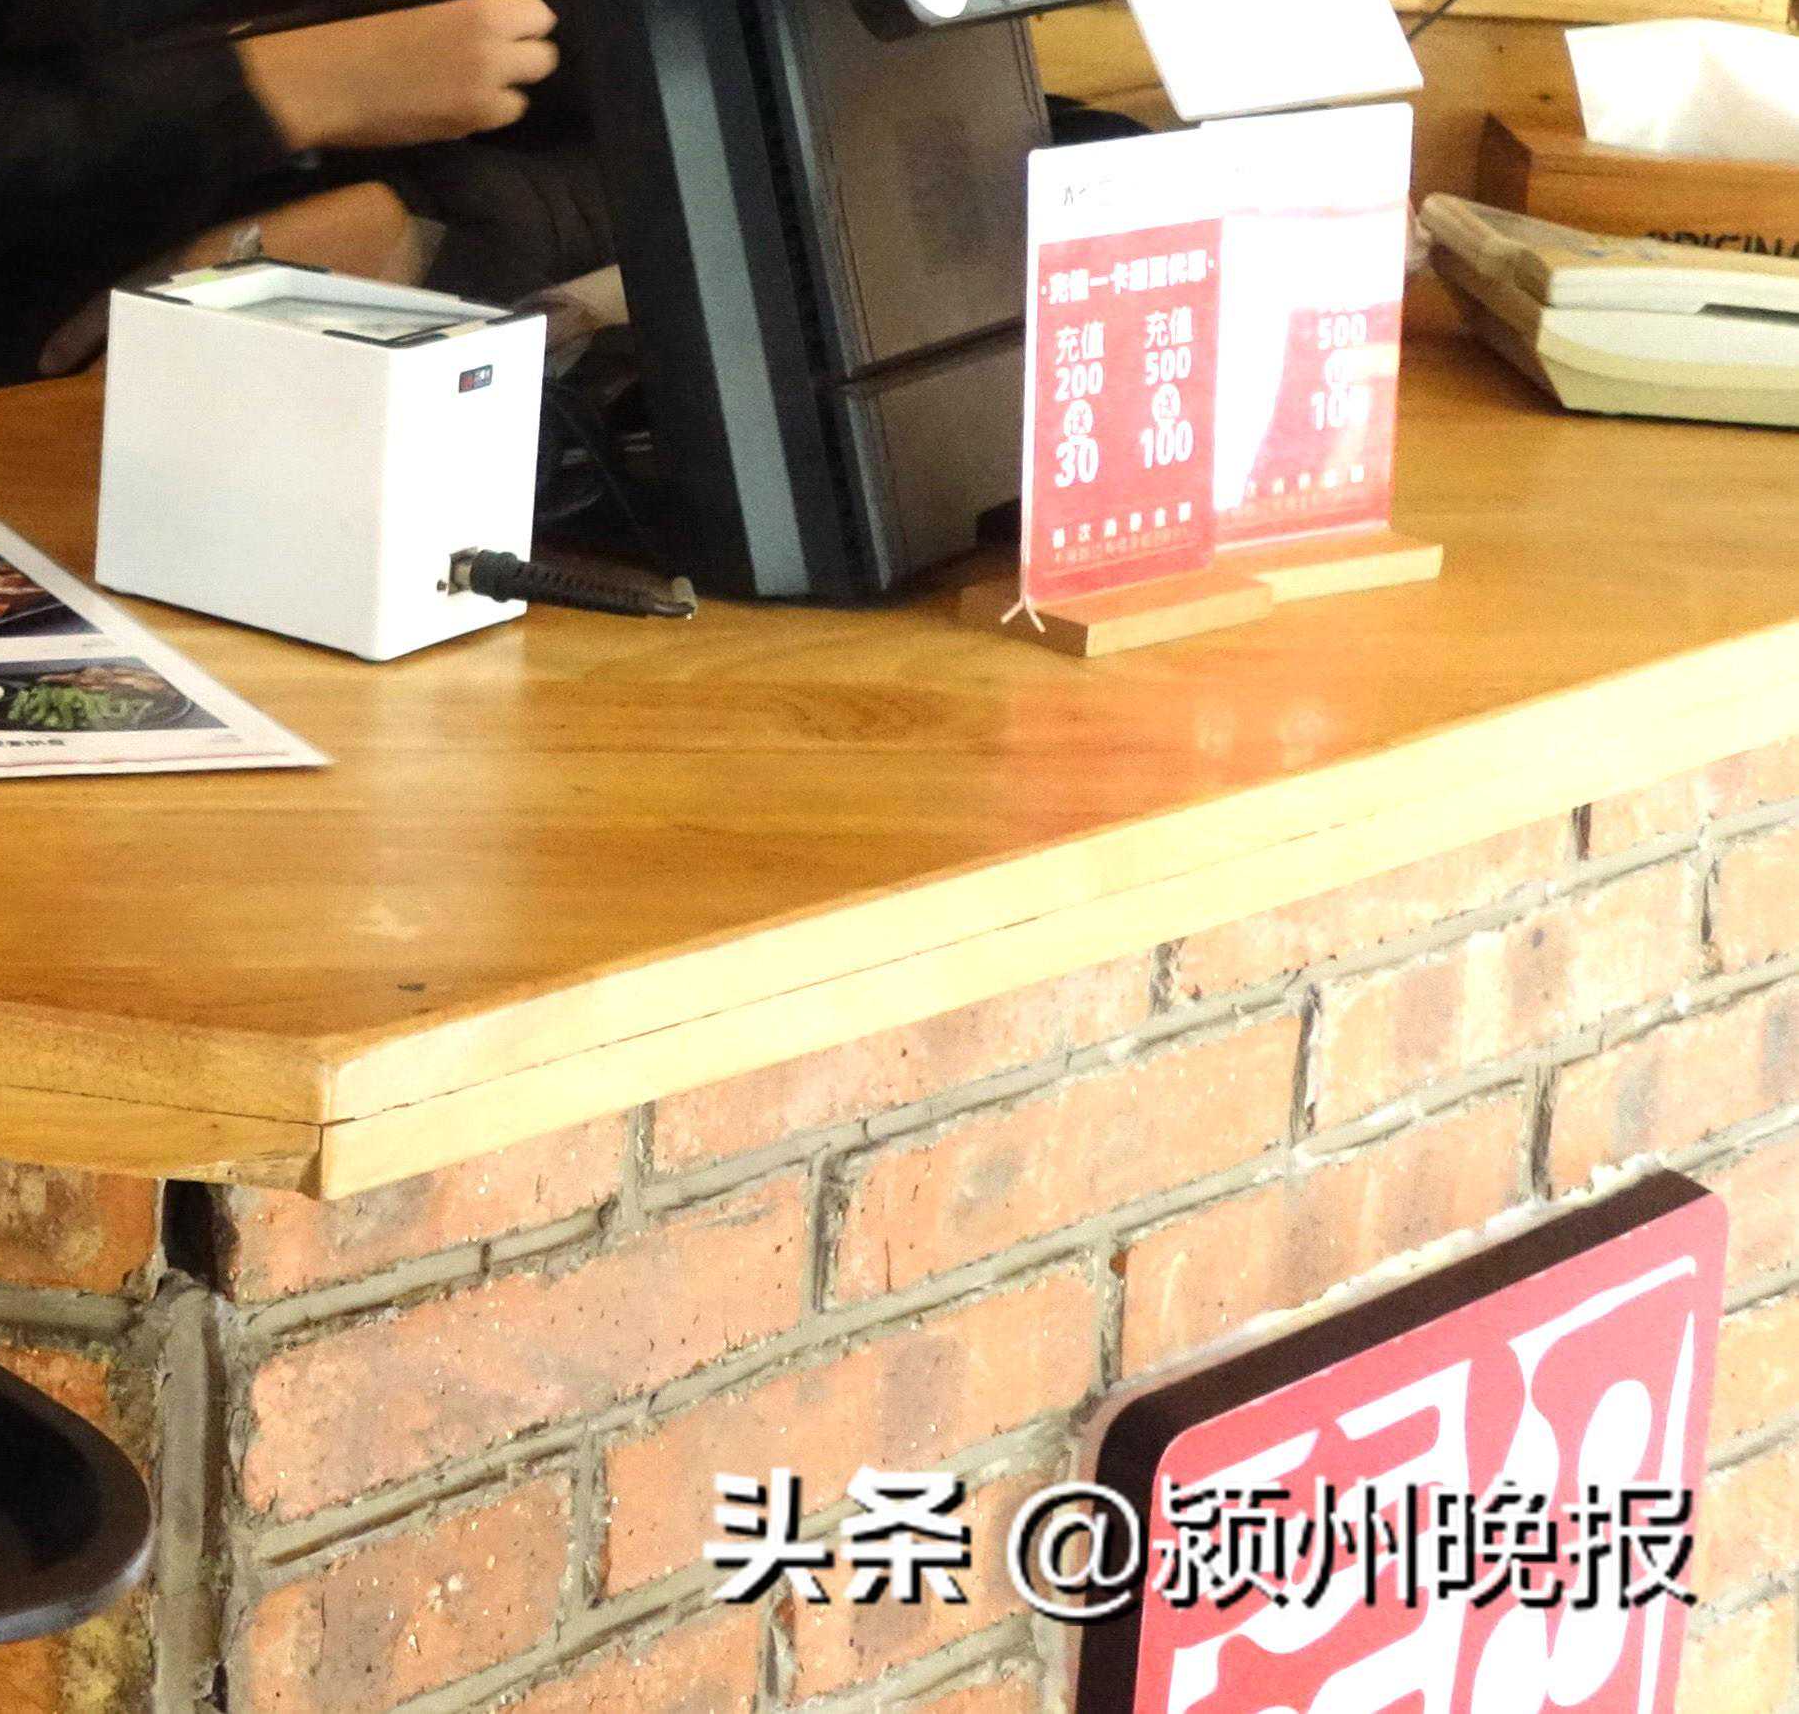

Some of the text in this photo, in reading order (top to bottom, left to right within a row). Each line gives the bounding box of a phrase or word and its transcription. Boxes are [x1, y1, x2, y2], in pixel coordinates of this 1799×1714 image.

[1053, 361, 1105, 403] 200
[1144, 345, 1192, 386] 500
[1053, 436, 1100, 488] 30
[1139, 419, 1195, 469] 100
